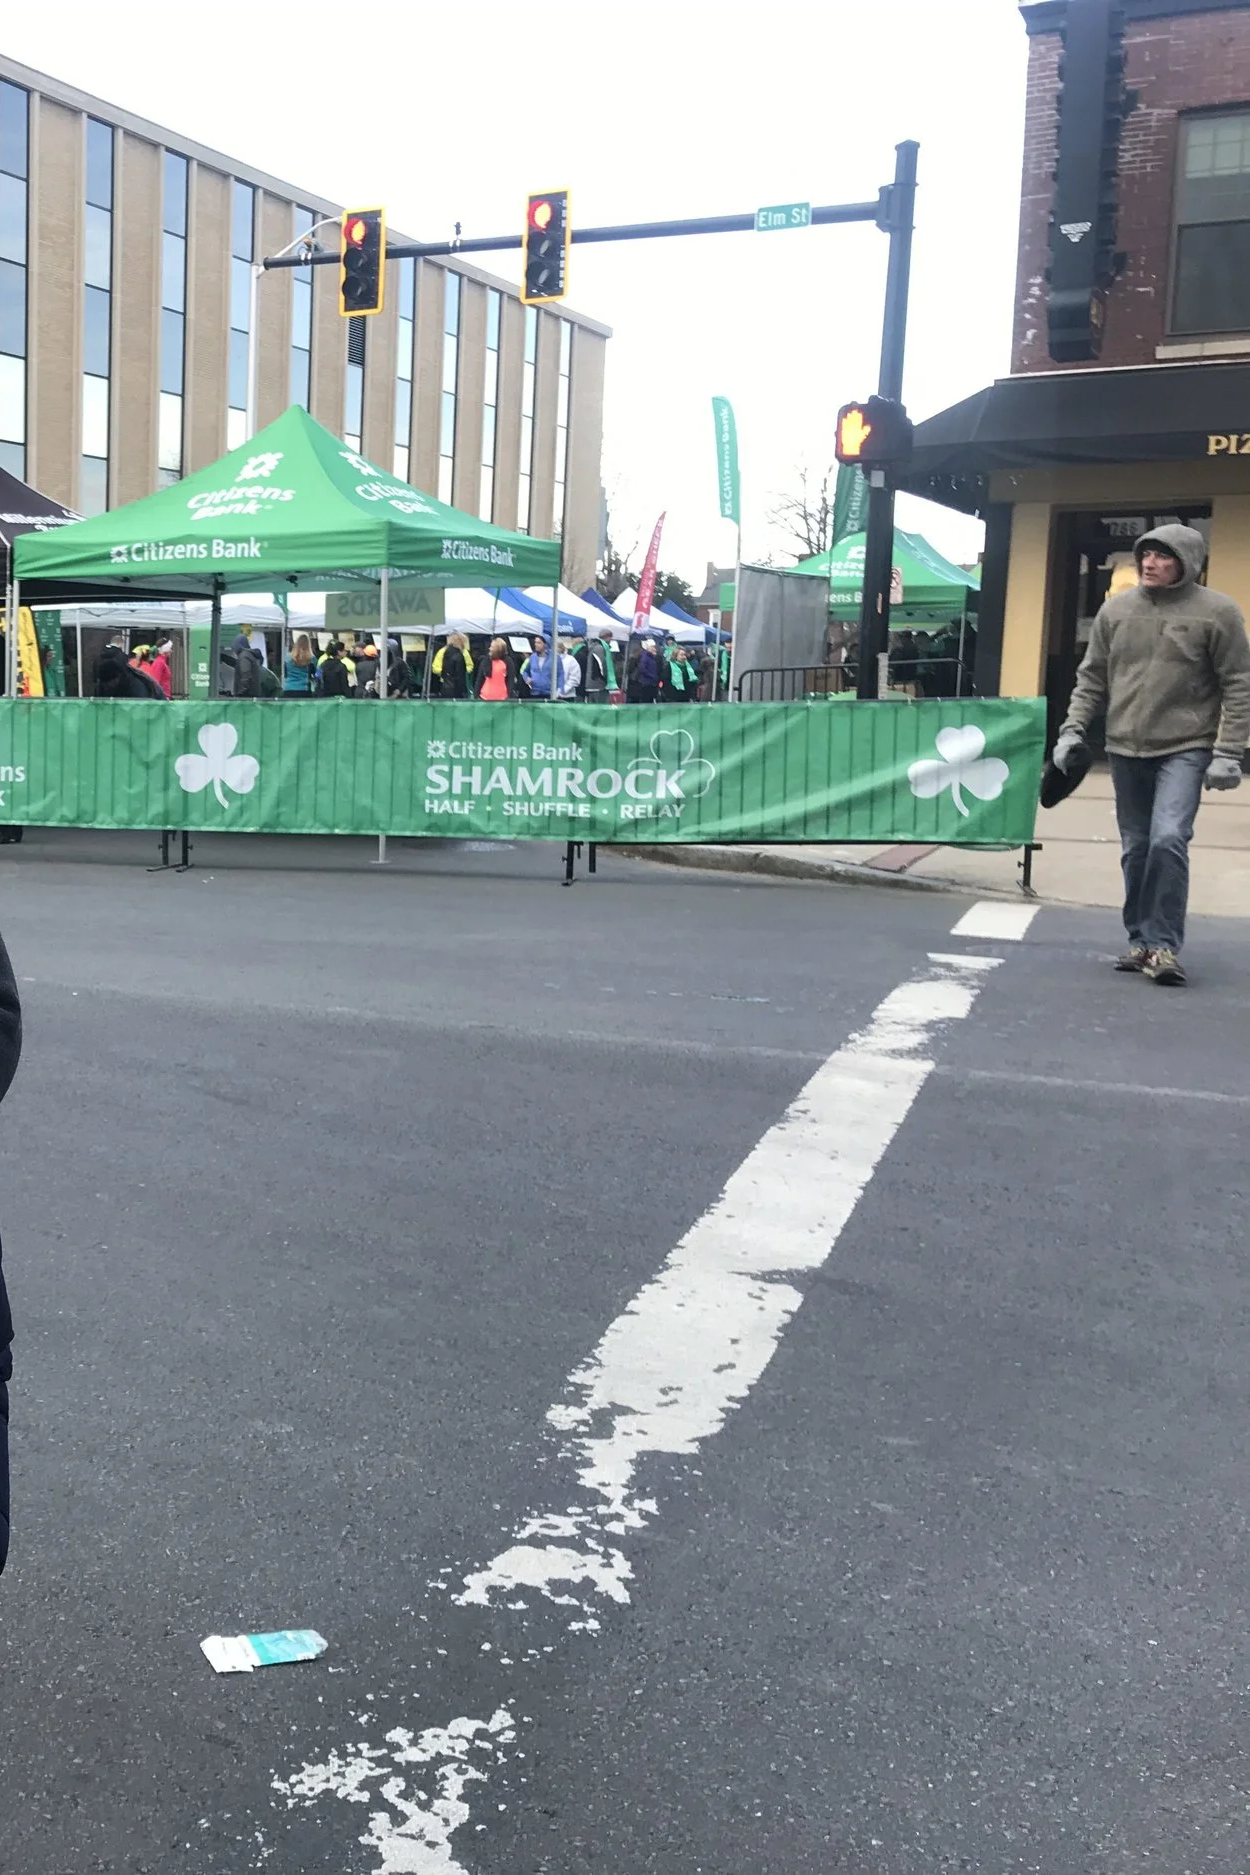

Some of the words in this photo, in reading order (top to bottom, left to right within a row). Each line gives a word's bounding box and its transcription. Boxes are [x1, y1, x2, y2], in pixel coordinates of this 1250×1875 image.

[758, 211, 787, 228] Elm
[790, 207, 808, 224] St
[187, 485, 297, 509] Citizens
[190, 499, 263, 520] Bank
[130, 542, 207, 562] Citizens
[211, 537, 262, 559] Bank
[451, 540, 491, 563] Citizens
[490, 545, 515, 568] Bank
[447, 741, 528, 761] Citizens
[532, 742, 584, 762] Bank
[424, 764, 687, 800] SHAMROCK
[424, 799, 476, 815] HALF
[502, 801, 592, 818] SHUFFLE
[619, 804, 687, 819] RELAY
